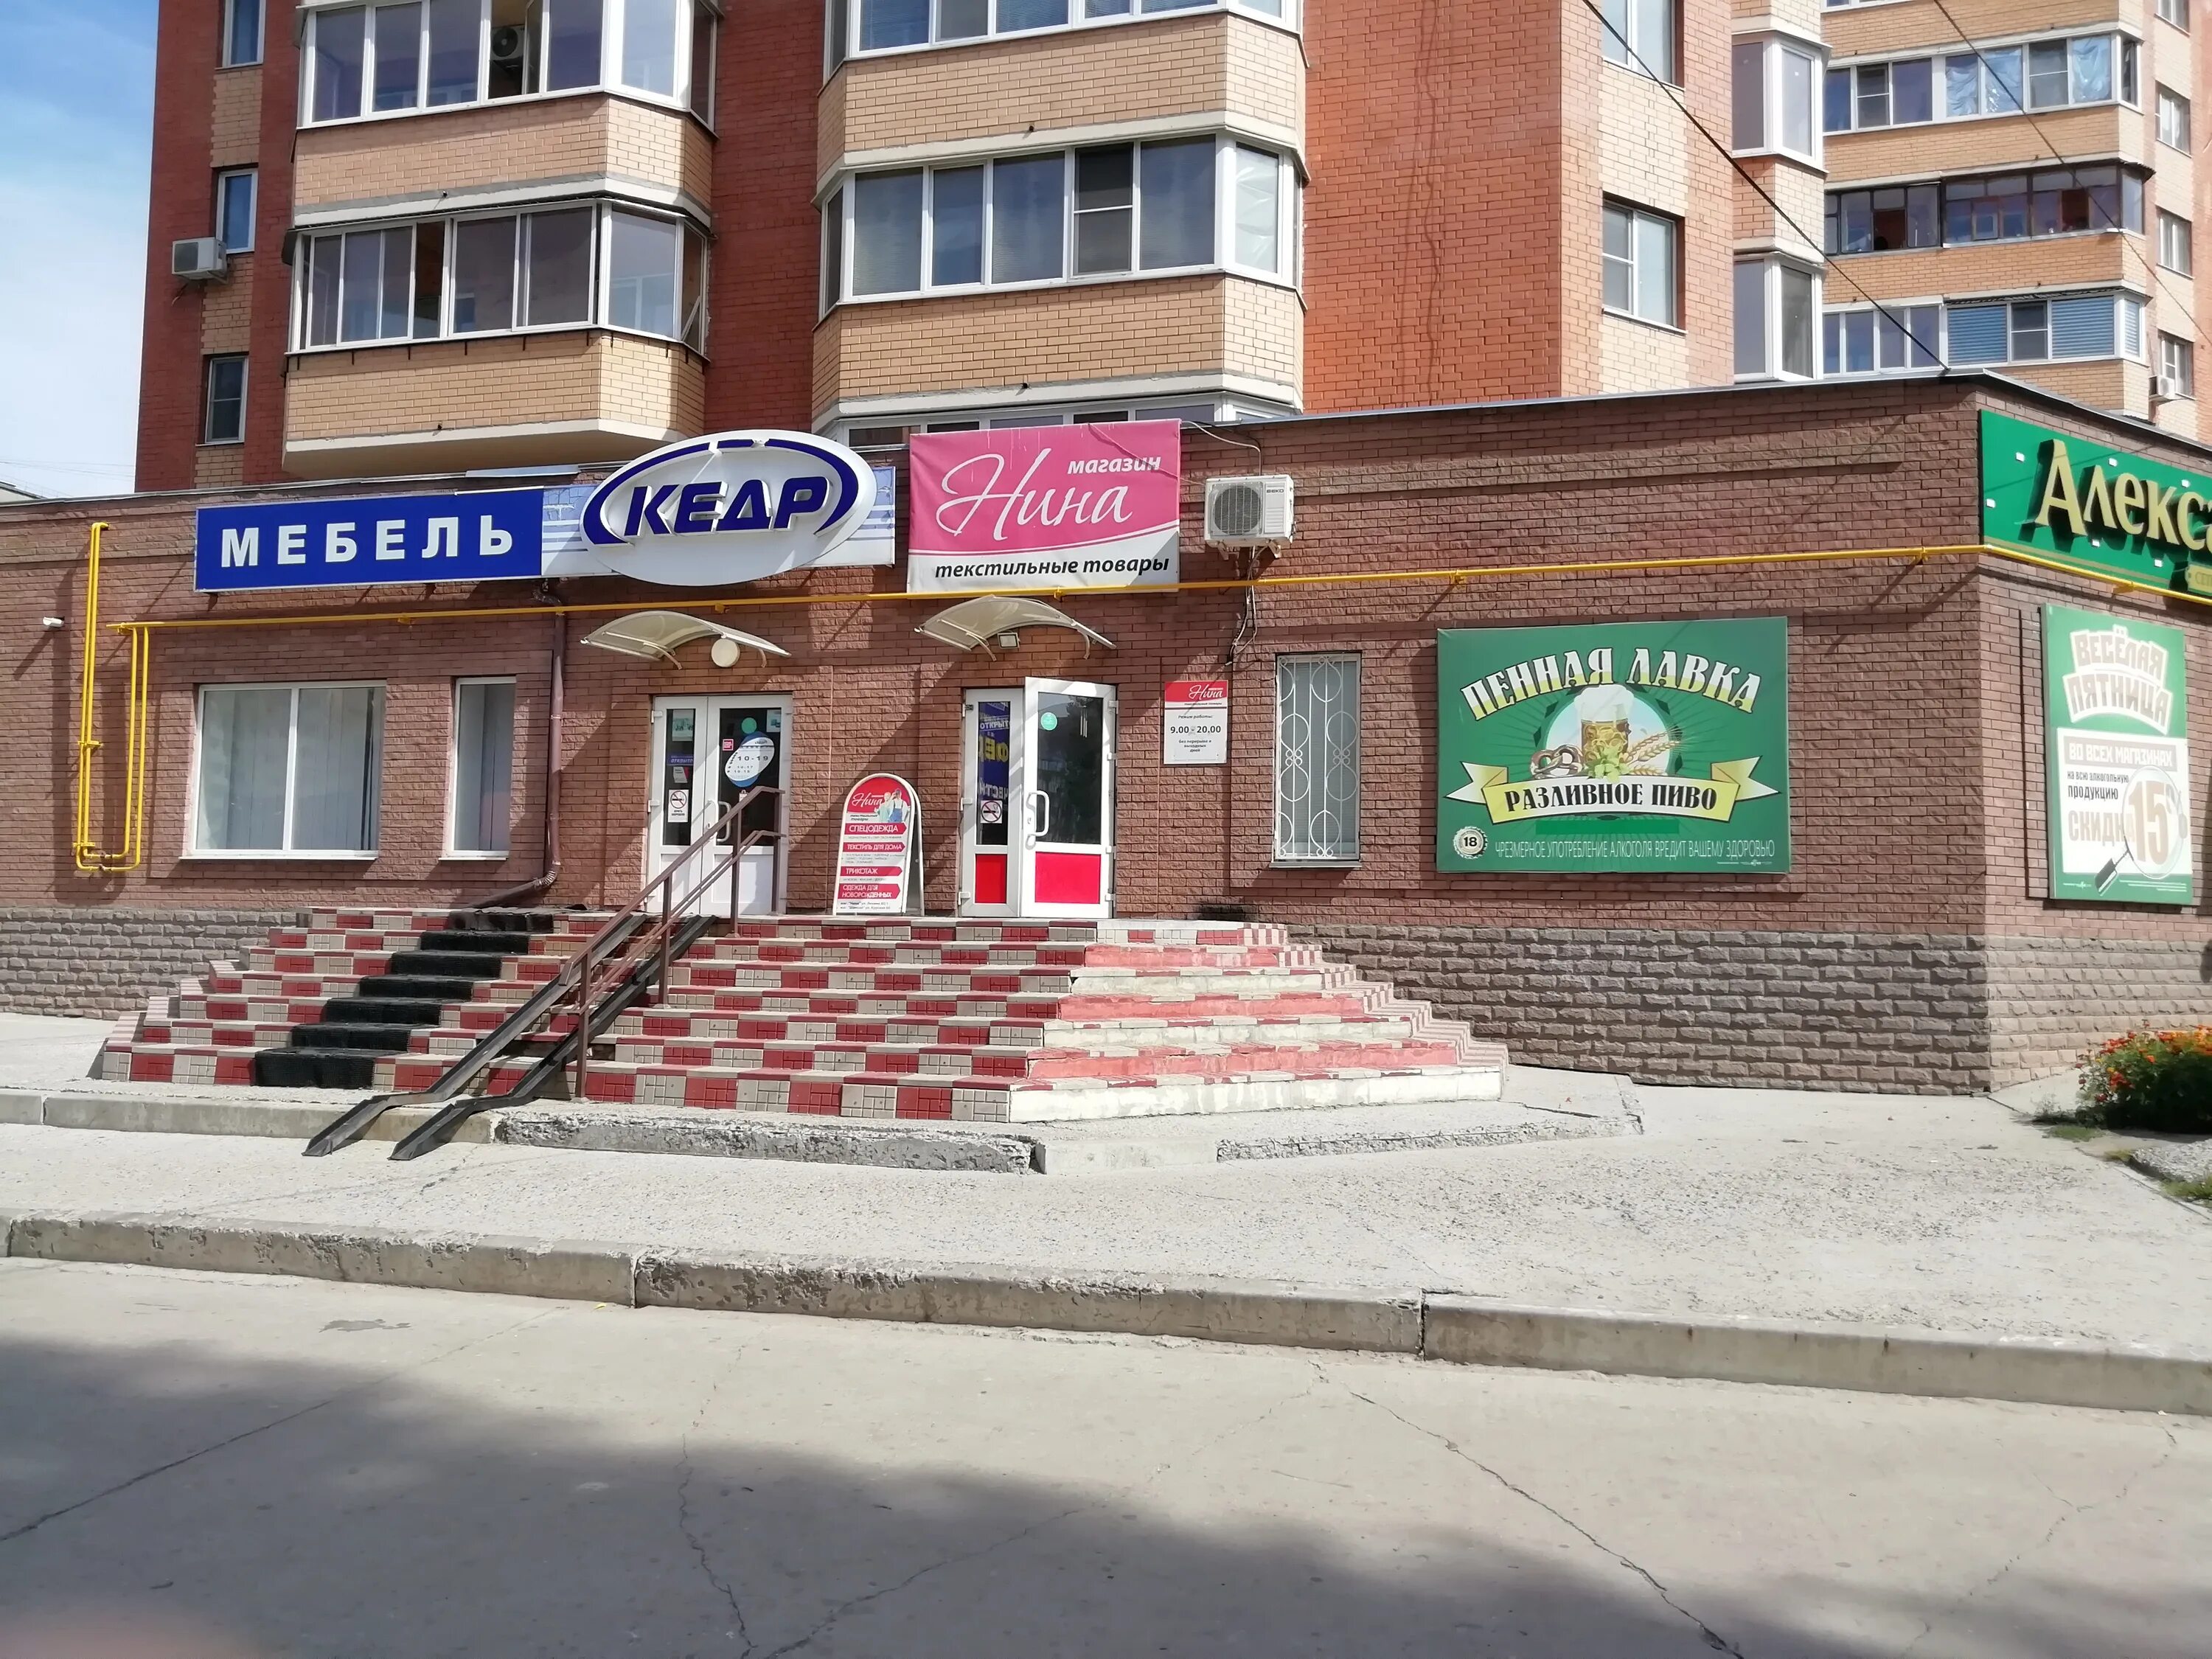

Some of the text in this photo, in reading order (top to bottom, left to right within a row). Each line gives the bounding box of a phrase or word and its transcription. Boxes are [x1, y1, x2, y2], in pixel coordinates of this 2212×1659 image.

[1067, 455, 1161, 475] магазин
[624, 476, 830, 537] КЕДР
[935, 448, 1133, 541] Нина
[2034, 439, 2212, 554] Алекс
[220, 515, 513, 568] МЕБЕЛЬ
[935, 556, 1169, 579] текстильные товары
[2073, 626, 2166, 680] ВЕСЁЛАЯ
[1188, 684, 1224, 700] Нина
[1460, 647, 1763, 721] ПЕННАЯ ЛАВКА
[2067, 674, 2171, 728] ПЯТНИЦА
[1170, 726, 1189, 734] 9.00
[1197, 726, 1221, 734] 20.00
[2068, 742, 2173, 767] ВО ВСЕХ МАГАЗИНАХ
[2067, 771, 2129, 784] на всю алкогольную
[1505, 783, 1717, 812] РАЗЛИВНОЕ ПИВО
[2067, 785, 2118, 801] продукцию
[849, 824, 899, 833] СПЕЦОДЕЖДА
[1464, 836, 1478, 847] 18
[1495, 841, 1546, 858] ЧРЕЗМЕРНОЕ
[1546, 841, 1608, 858] УПОТРЕБЛЕНИЕ
[1609, 841, 1652, 858] АЛКОГОЛЯ
[1655, 840, 1687, 860] ВРЕДИТ
[1688, 840, 1725, 858] ВАШЕМУ
[1725, 839, 1775, 860] ЗДОРОВЬЮ
